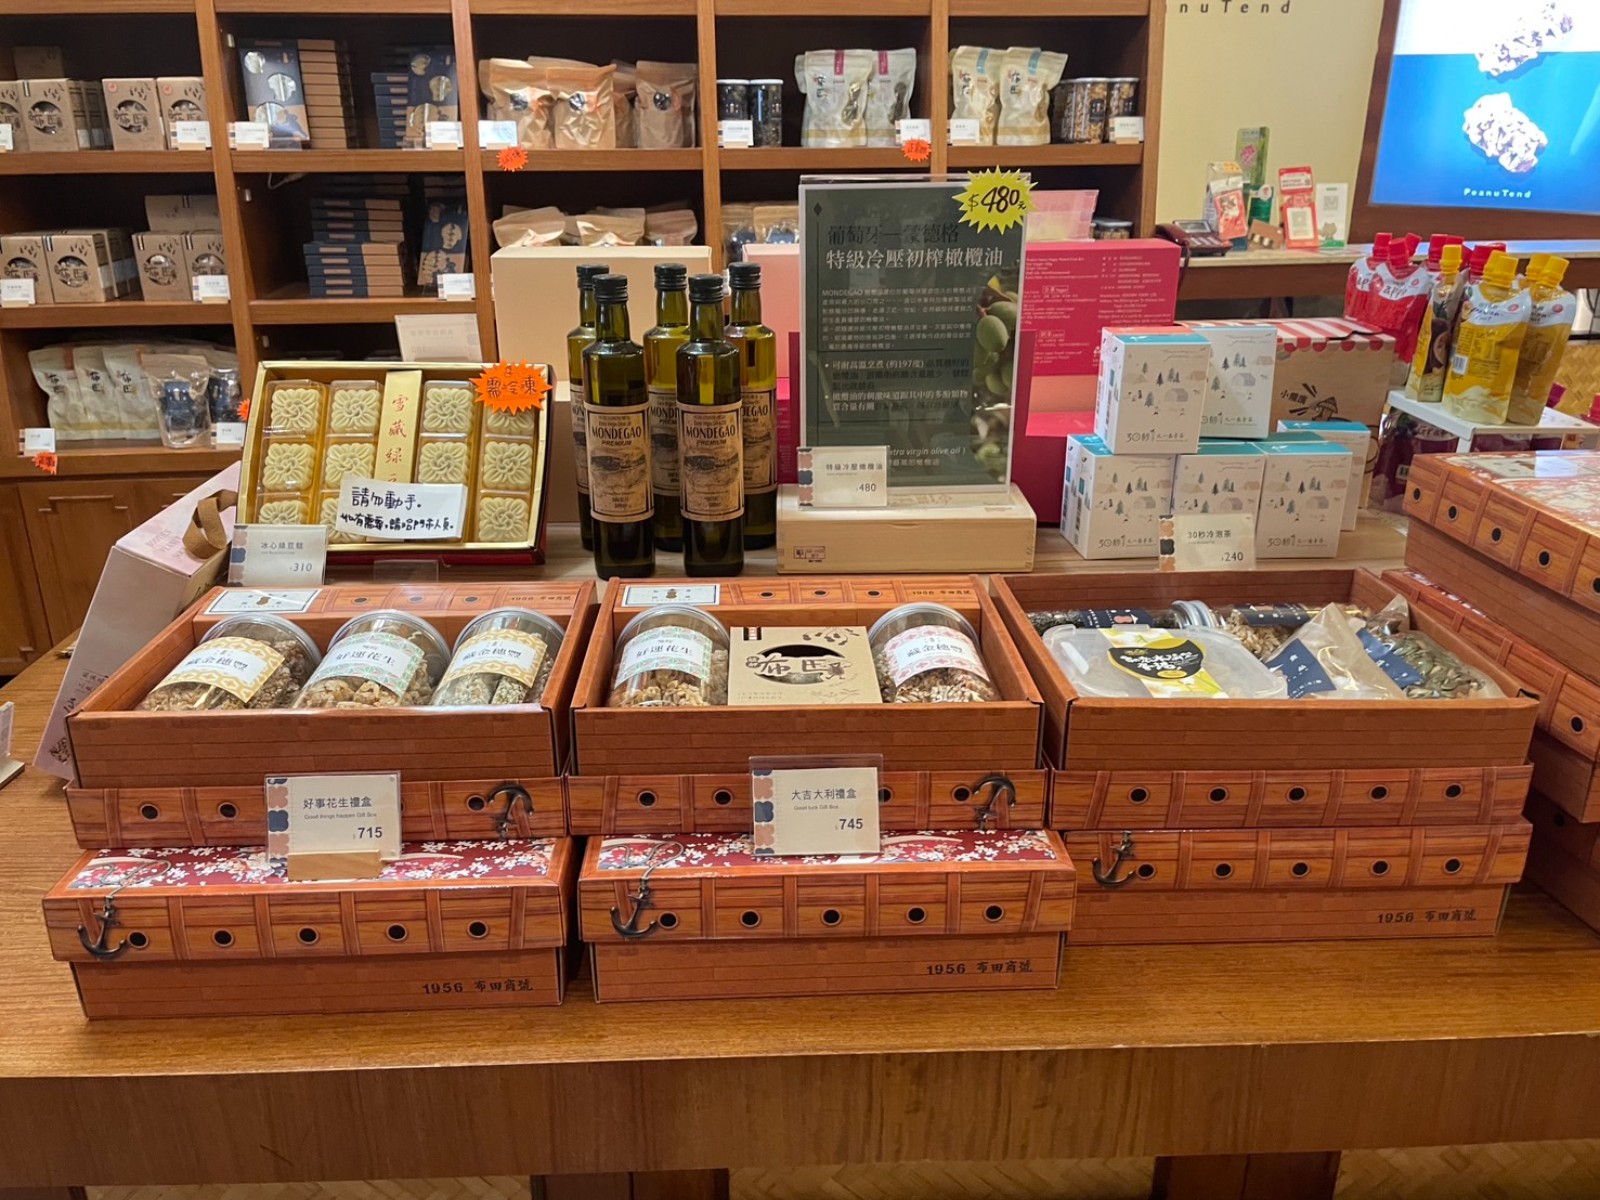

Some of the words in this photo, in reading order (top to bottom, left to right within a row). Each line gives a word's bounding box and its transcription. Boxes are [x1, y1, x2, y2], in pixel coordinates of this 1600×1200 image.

[1463, 187, 1532, 198] PeanuTend
[825, 247, 1004, 270] 特級冷壓初榨橄欖油
[591, 426, 642, 439] MONDEGAO
[686, 425, 736, 439] MONDEGAO
[906, 447, 929, 457] virgin
[930, 446, 948, 456] olive
[1187, 530, 1232, 539] 30秒冷泡茶
[791, 788, 857, 801] 大吉大利禮盒
[303, 796, 372, 809] 好事花生禮盒
[1378, 912, 1414, 924] 1956
[926, 963, 966, 976] 1956
[422, 982, 463, 995] 1956
